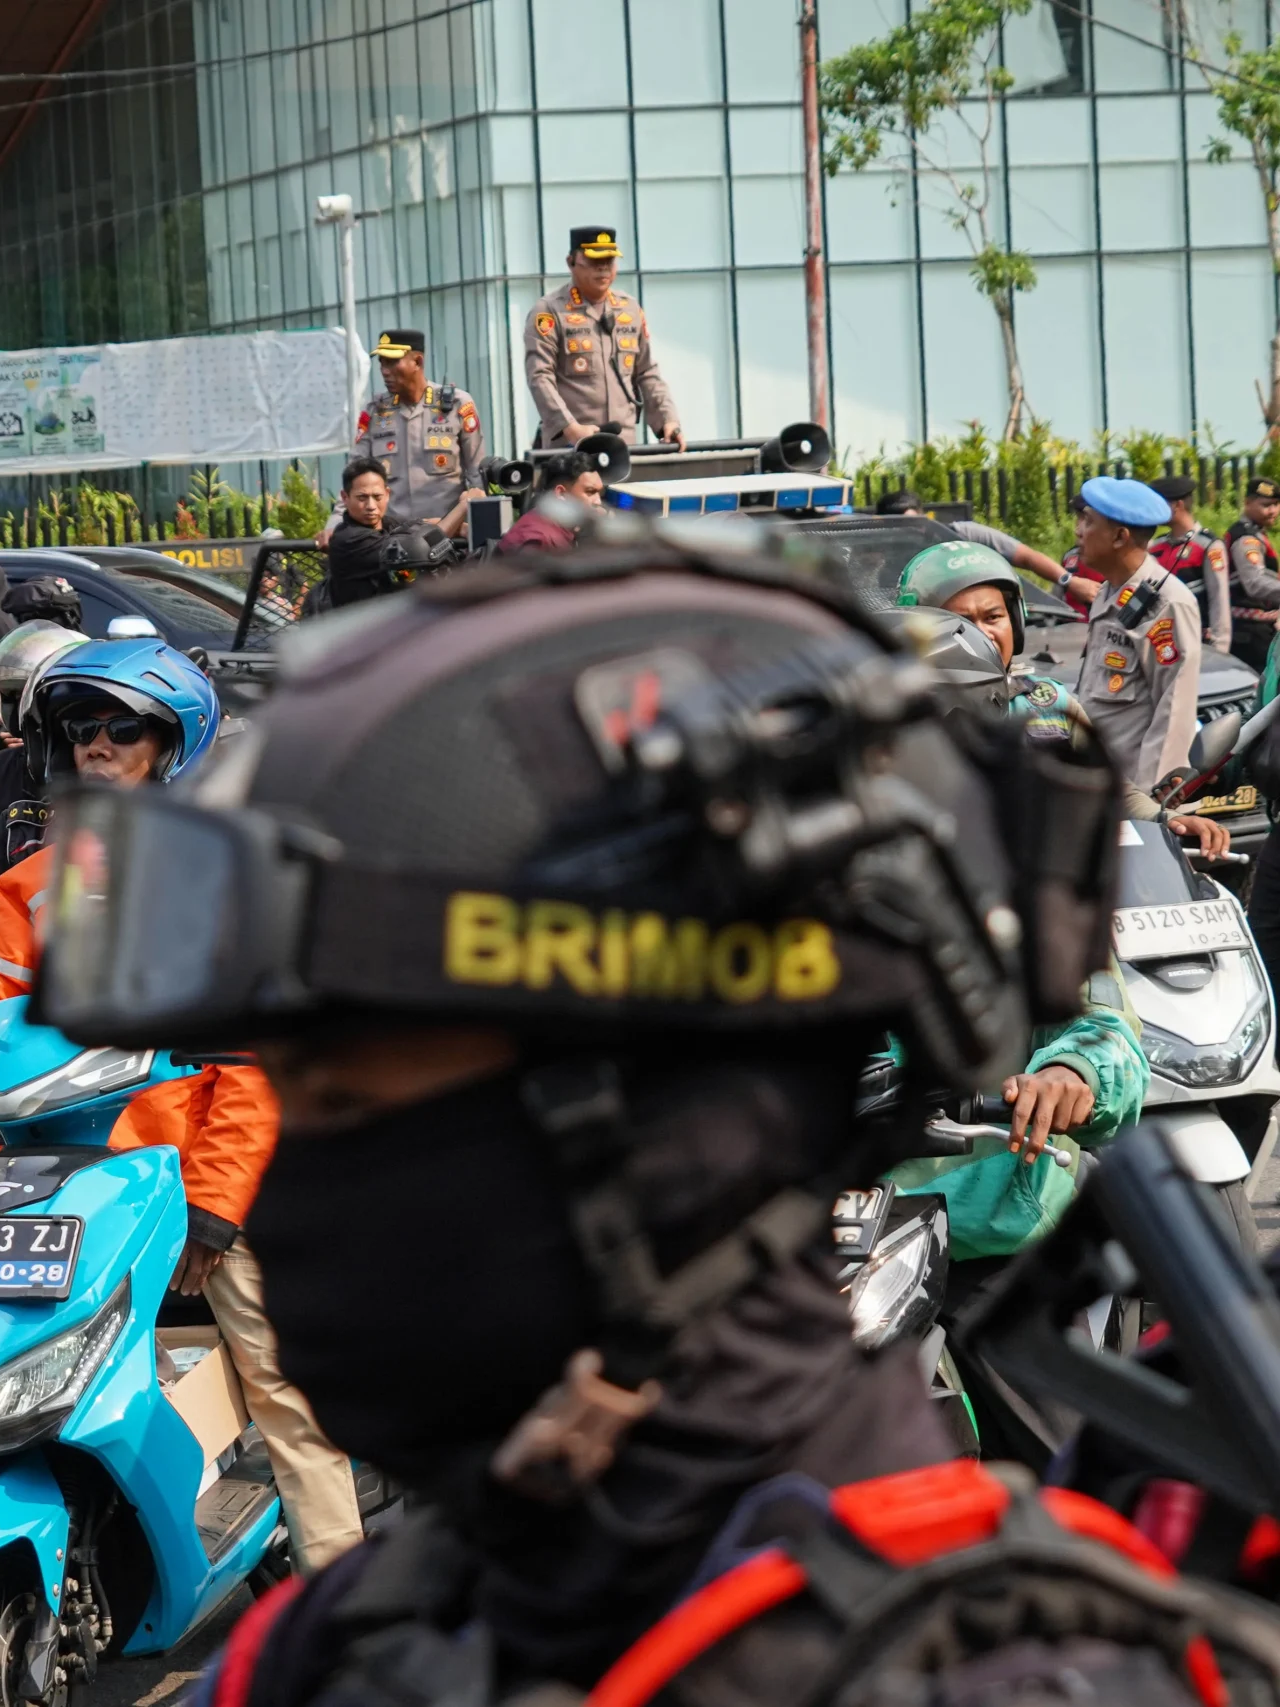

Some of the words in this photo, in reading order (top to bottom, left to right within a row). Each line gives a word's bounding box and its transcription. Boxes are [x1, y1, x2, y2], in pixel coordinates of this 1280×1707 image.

[1131, 908, 1187, 931] 5120
[1188, 903, 1233, 926] SAM
[445, 891, 842, 1001] BRIMOB
[1168, 968, 1207, 978] HONDA
[28, 1224, 70, 1253] ZJ
